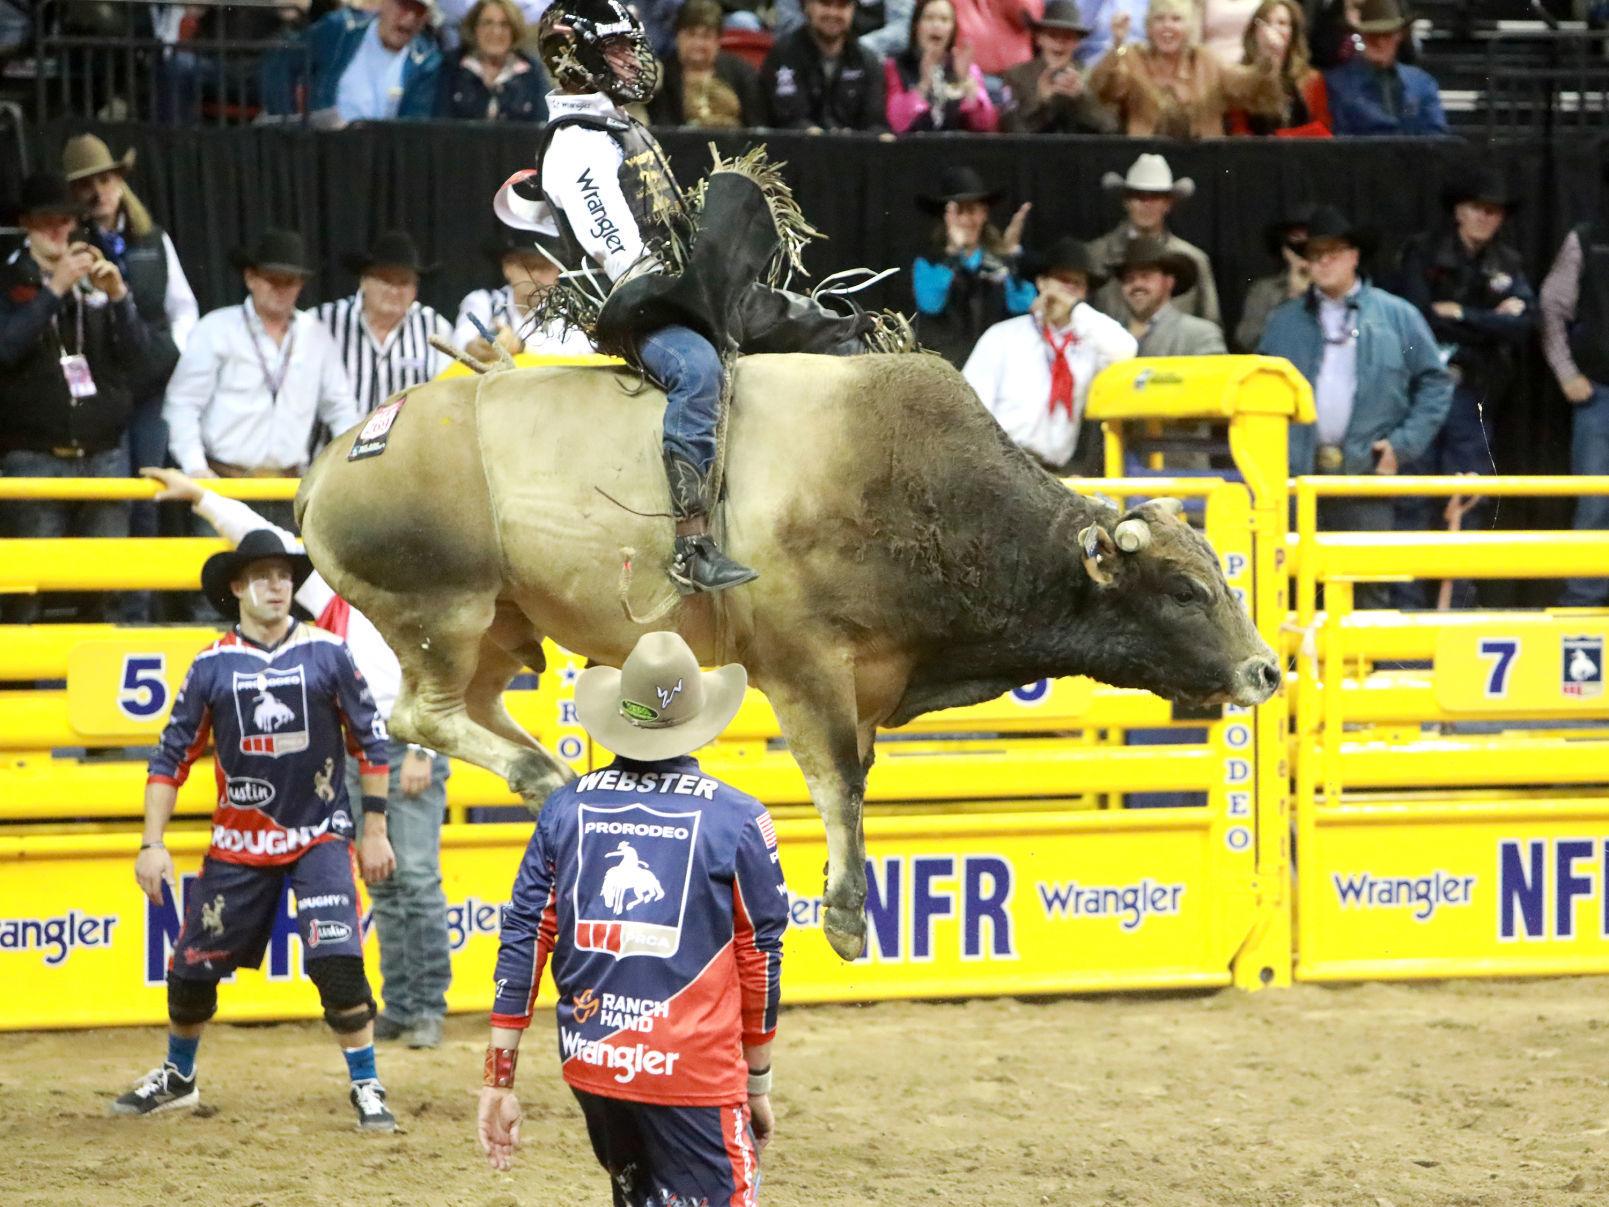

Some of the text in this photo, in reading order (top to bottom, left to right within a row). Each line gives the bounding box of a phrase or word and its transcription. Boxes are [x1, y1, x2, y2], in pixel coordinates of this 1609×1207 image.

[576, 167, 626, 254] Wrangler
[121, 657, 166, 716] 5
[1481, 642, 1517, 693] 7
[575, 769, 719, 801] WEBSTER
[584, 821, 689, 840] PRORODEO
[860, 857, 1012, 959] NFR
[1040, 881, 1182, 928] Wrangler
[1334, 873, 1474, 919] Wrangler
[1500, 841, 1609, 937] NF
[623, 932, 670, 949] PRCA
[600, 1009, 654, 1033] HAND
[602, 992, 670, 1018] RANCH
[561, 1026, 680, 1084] Wrangler
